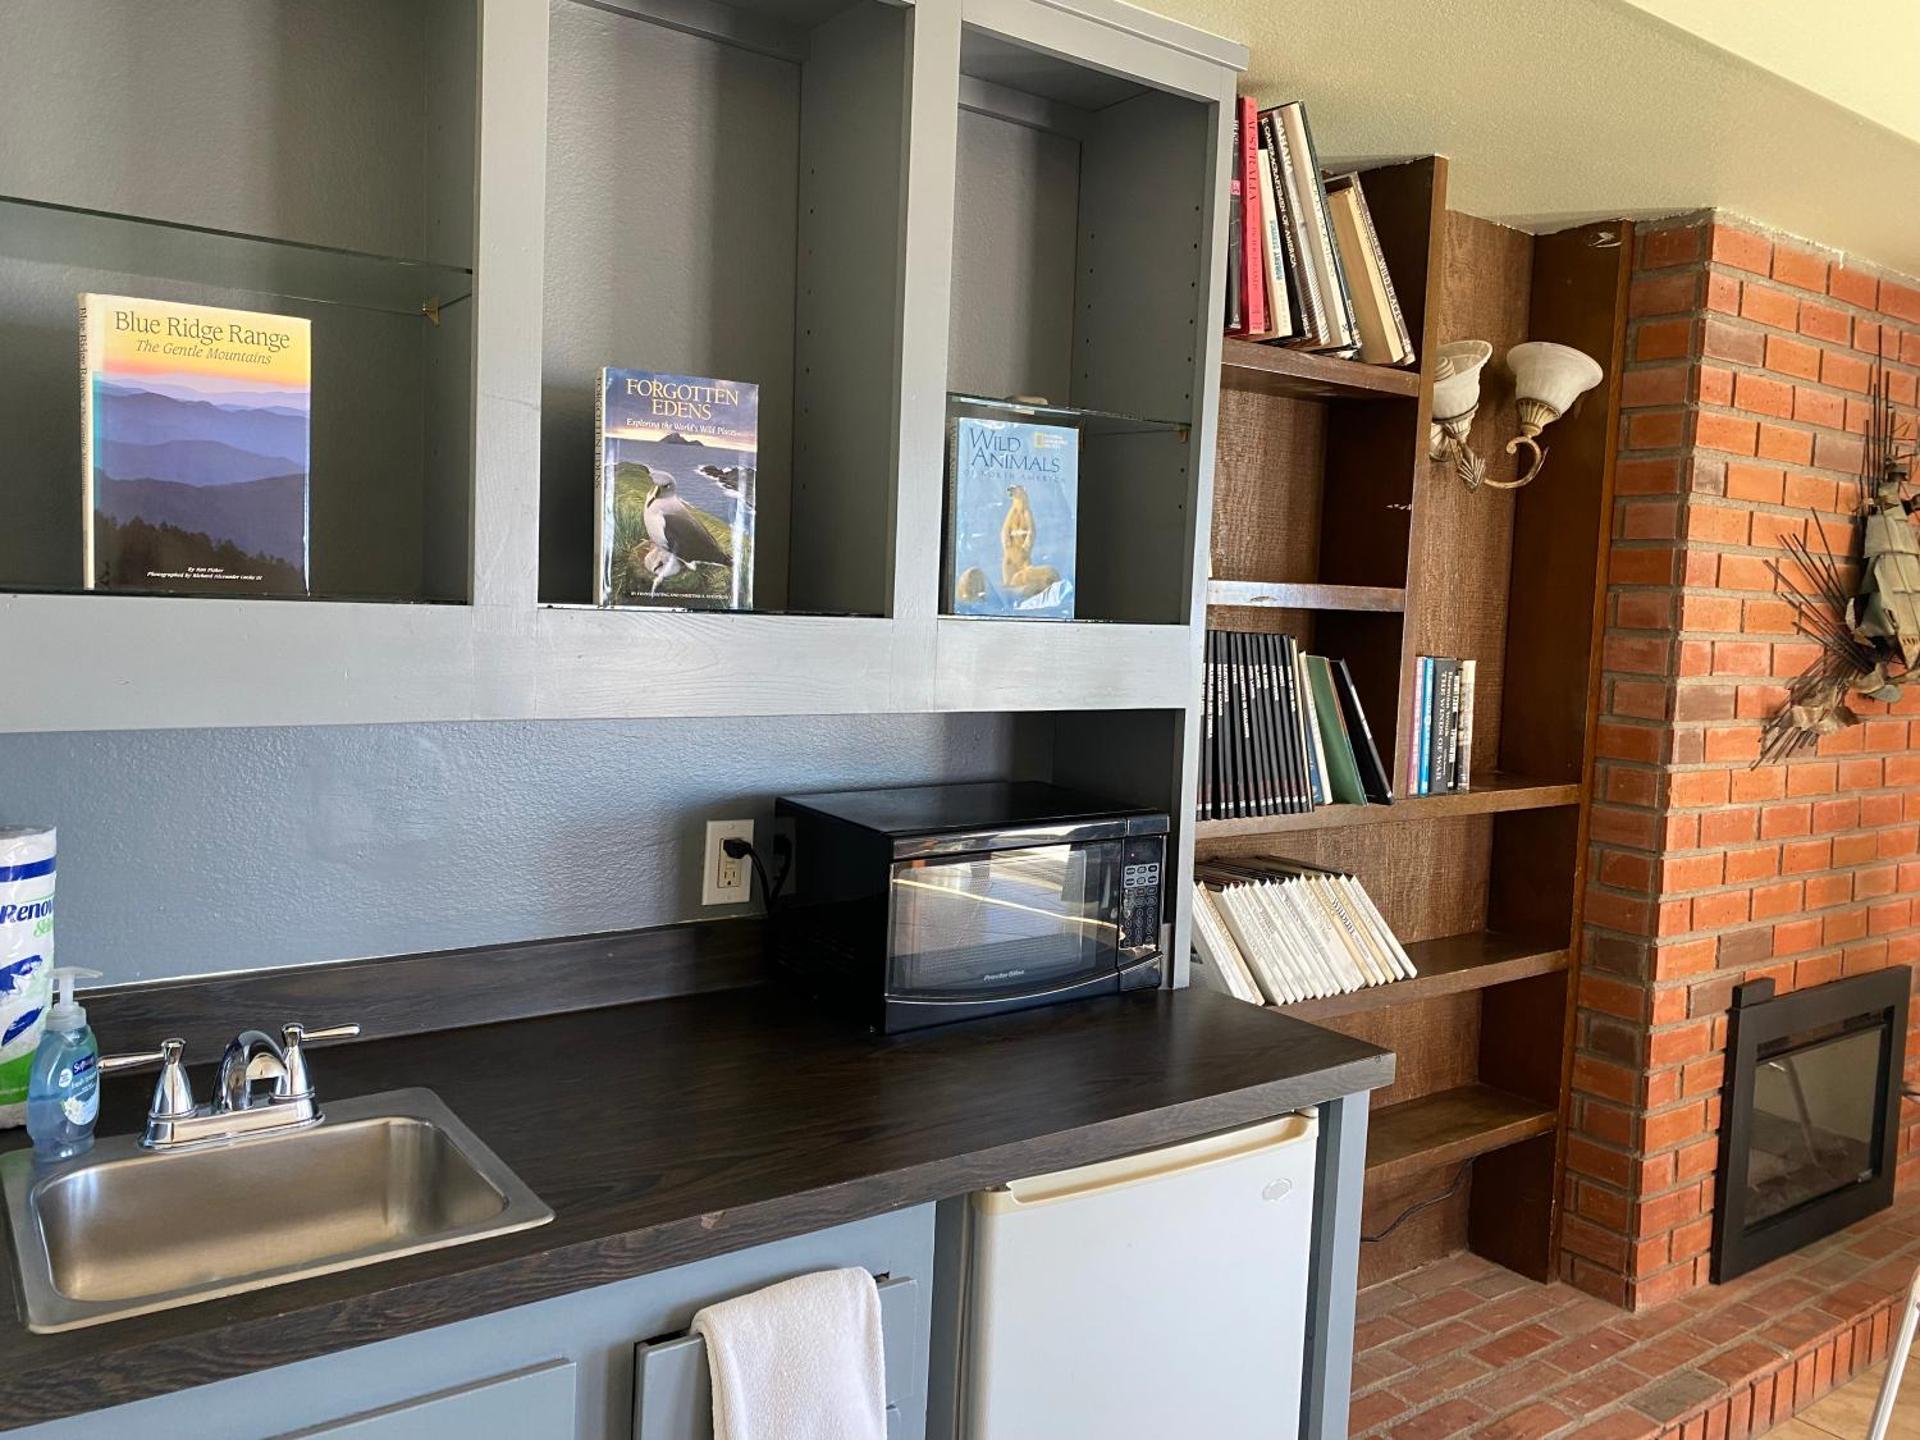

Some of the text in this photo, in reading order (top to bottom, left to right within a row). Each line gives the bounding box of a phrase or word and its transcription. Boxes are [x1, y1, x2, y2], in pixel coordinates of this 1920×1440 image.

[1247, 117, 1257, 201] AUSTRALIA
[1276, 117, 1292, 175] SAHARA
[1378, 259, 1391, 285] WILD
[1386, 287, 1402, 322] PLACES
[115, 310, 290, 353] Blue Ridge Range
[136, 339, 272, 365] The Gentle Mountains
[625, 378, 739, 407] FORGOTTEN
[651, 398, 712, 421] EDENS
[626, 418, 660, 430] Exploring
[971, 446, 1060, 473] ANIMALS
[1437, 737, 1443, 752] OF
